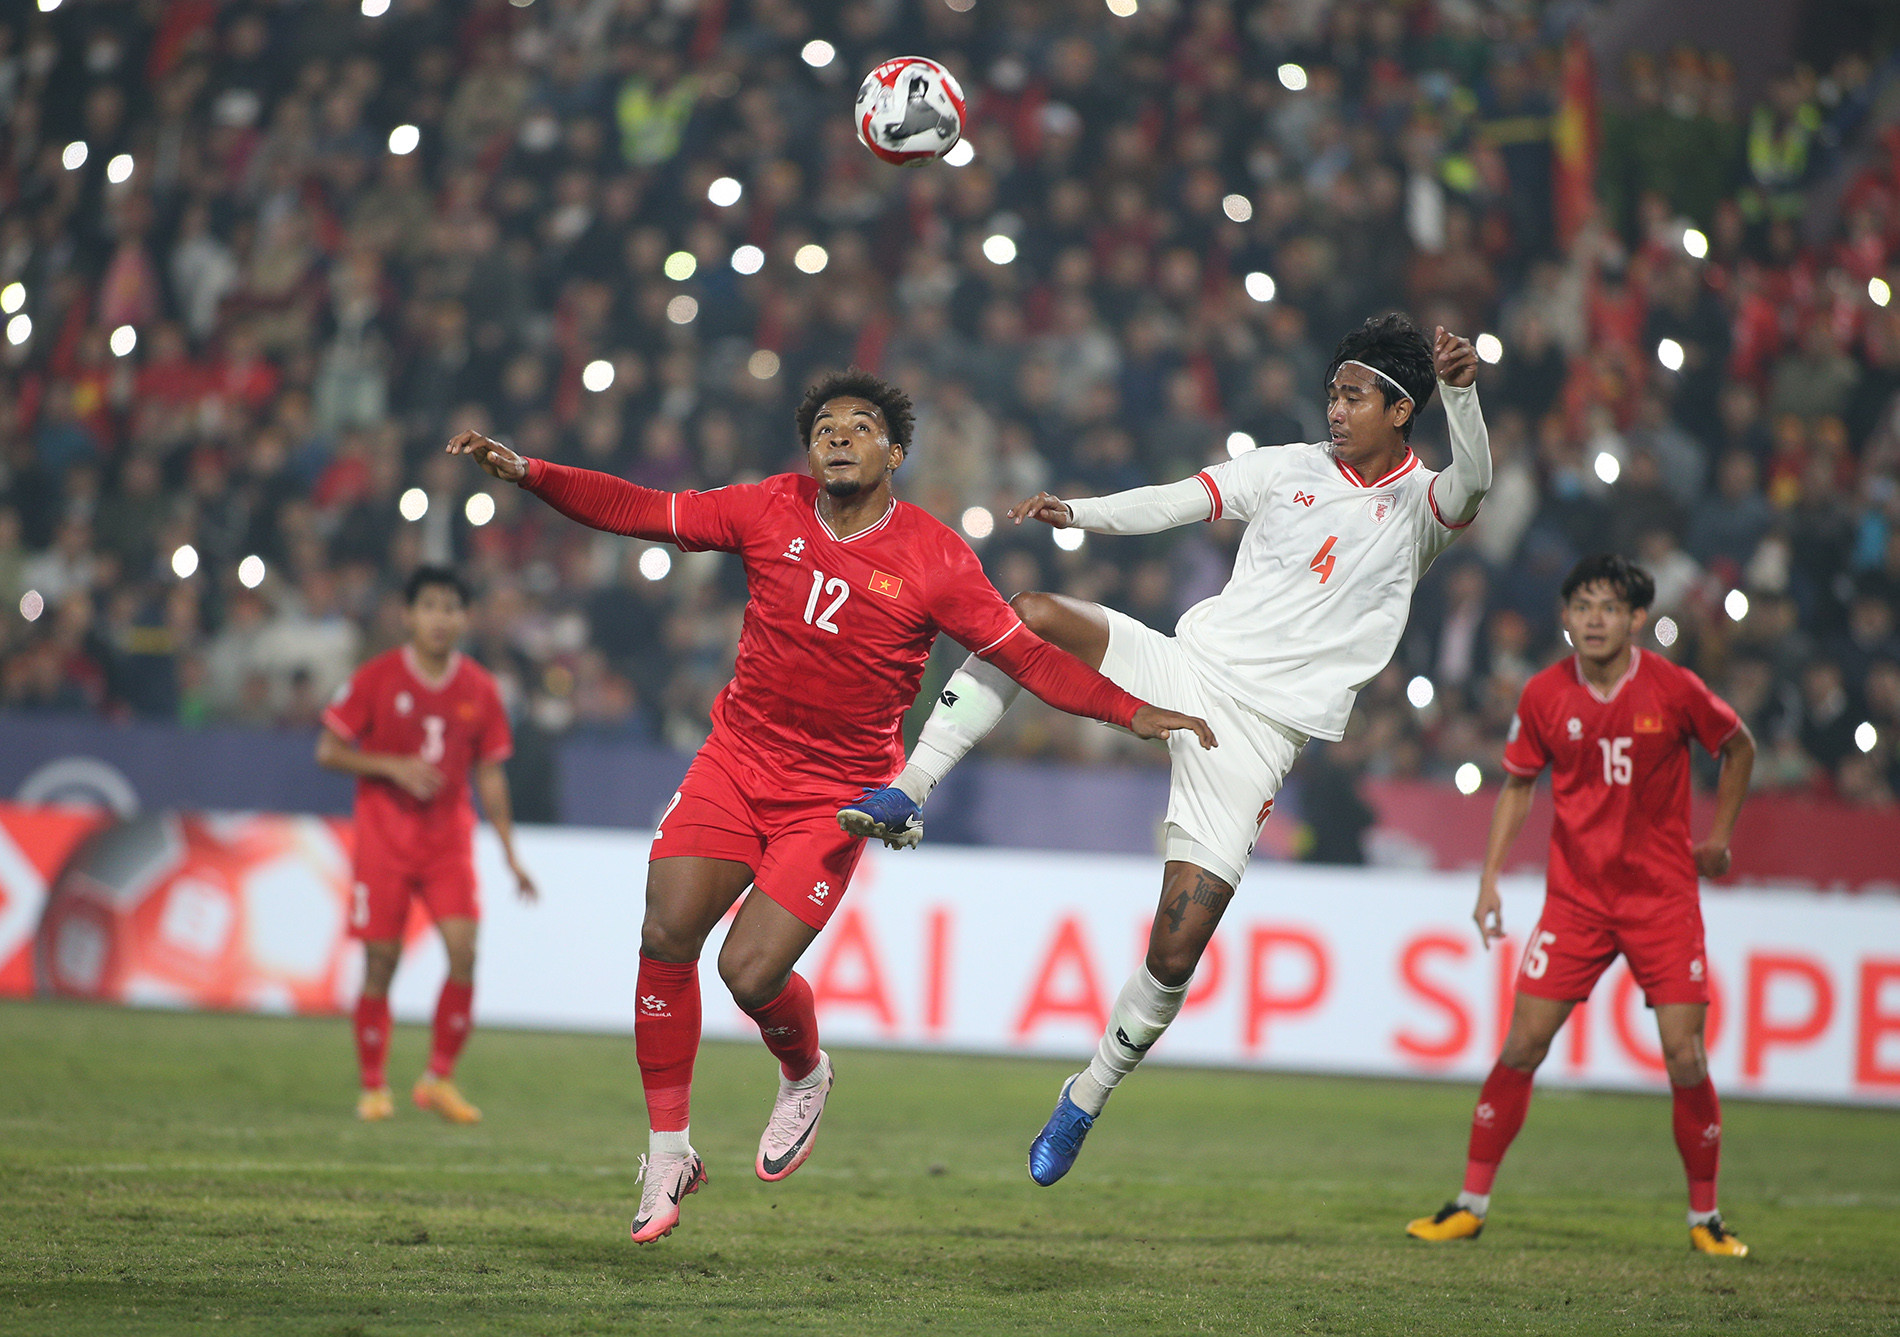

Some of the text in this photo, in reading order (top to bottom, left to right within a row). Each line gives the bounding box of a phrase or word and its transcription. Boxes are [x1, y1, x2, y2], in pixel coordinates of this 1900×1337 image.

[1309, 535, 1338, 584] 4
[803, 569, 850, 634] 12
[1598, 736, 1633, 786] 15
